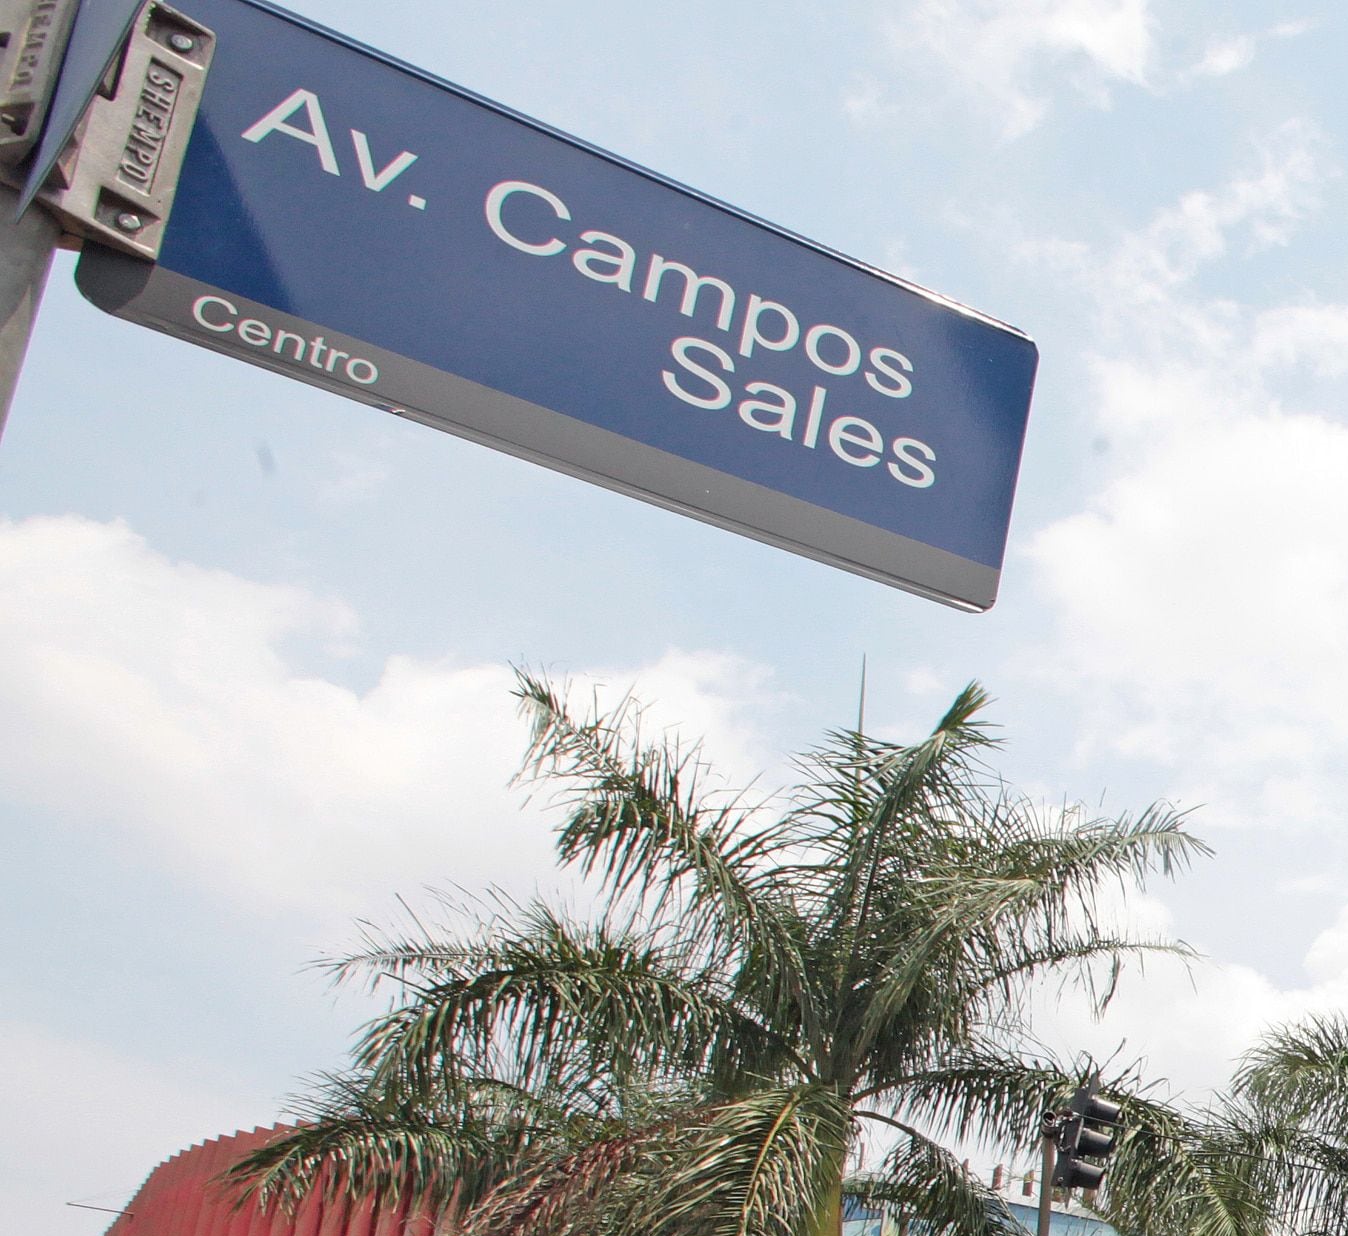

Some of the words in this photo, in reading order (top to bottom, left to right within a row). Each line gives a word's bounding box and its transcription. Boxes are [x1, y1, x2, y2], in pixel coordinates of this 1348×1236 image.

[119, 71, 175, 185] SHEMPO
[241, 88, 427, 211] Av.
[485, 180, 914, 399] Campos
[192, 295, 379, 385] Centro
[661, 335, 937, 489] Sales
